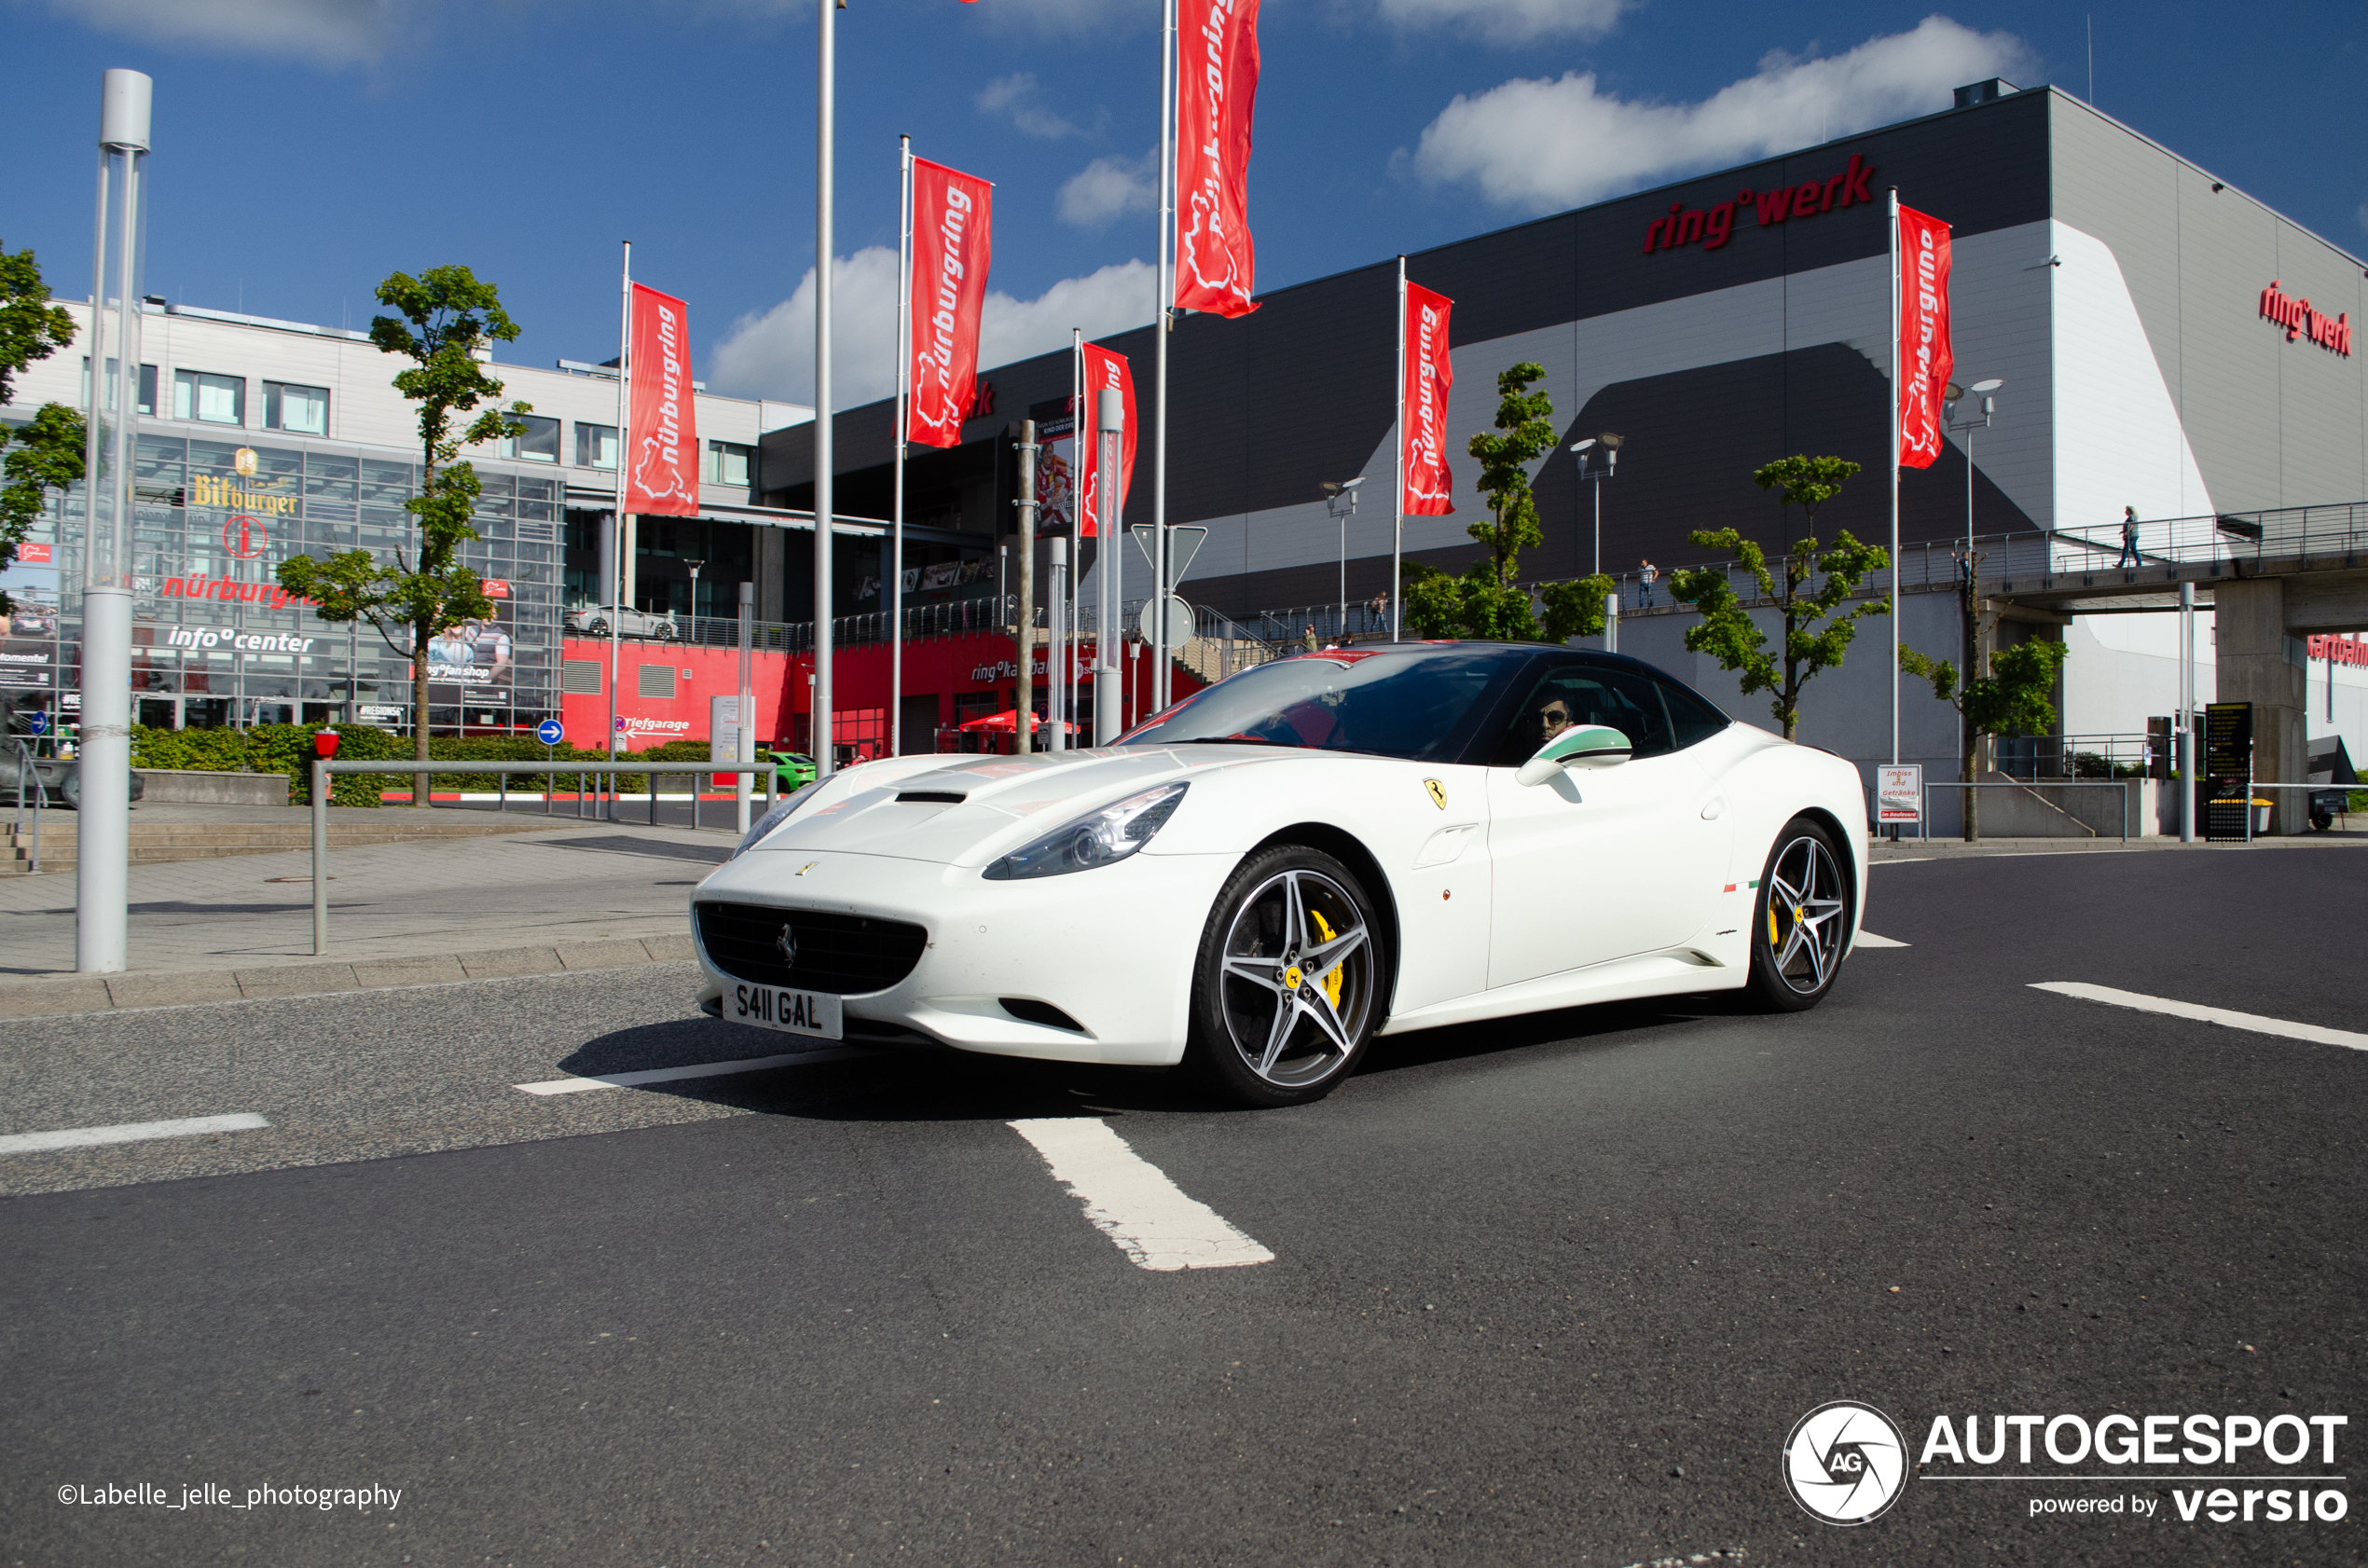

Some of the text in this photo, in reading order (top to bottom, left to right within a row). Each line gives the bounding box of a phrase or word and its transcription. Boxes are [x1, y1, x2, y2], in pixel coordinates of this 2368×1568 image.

[932, 186, 971, 390] nürburgring
[657, 304, 681, 464] nürburgring
[1418, 304, 1439, 467] nürburgring
[193, 475, 297, 516] Bitburger
[162, 572, 329, 610] nürburg
[625, 718, 690, 732] Tiefgarage
[737, 984, 822, 1030] S411 GAL
